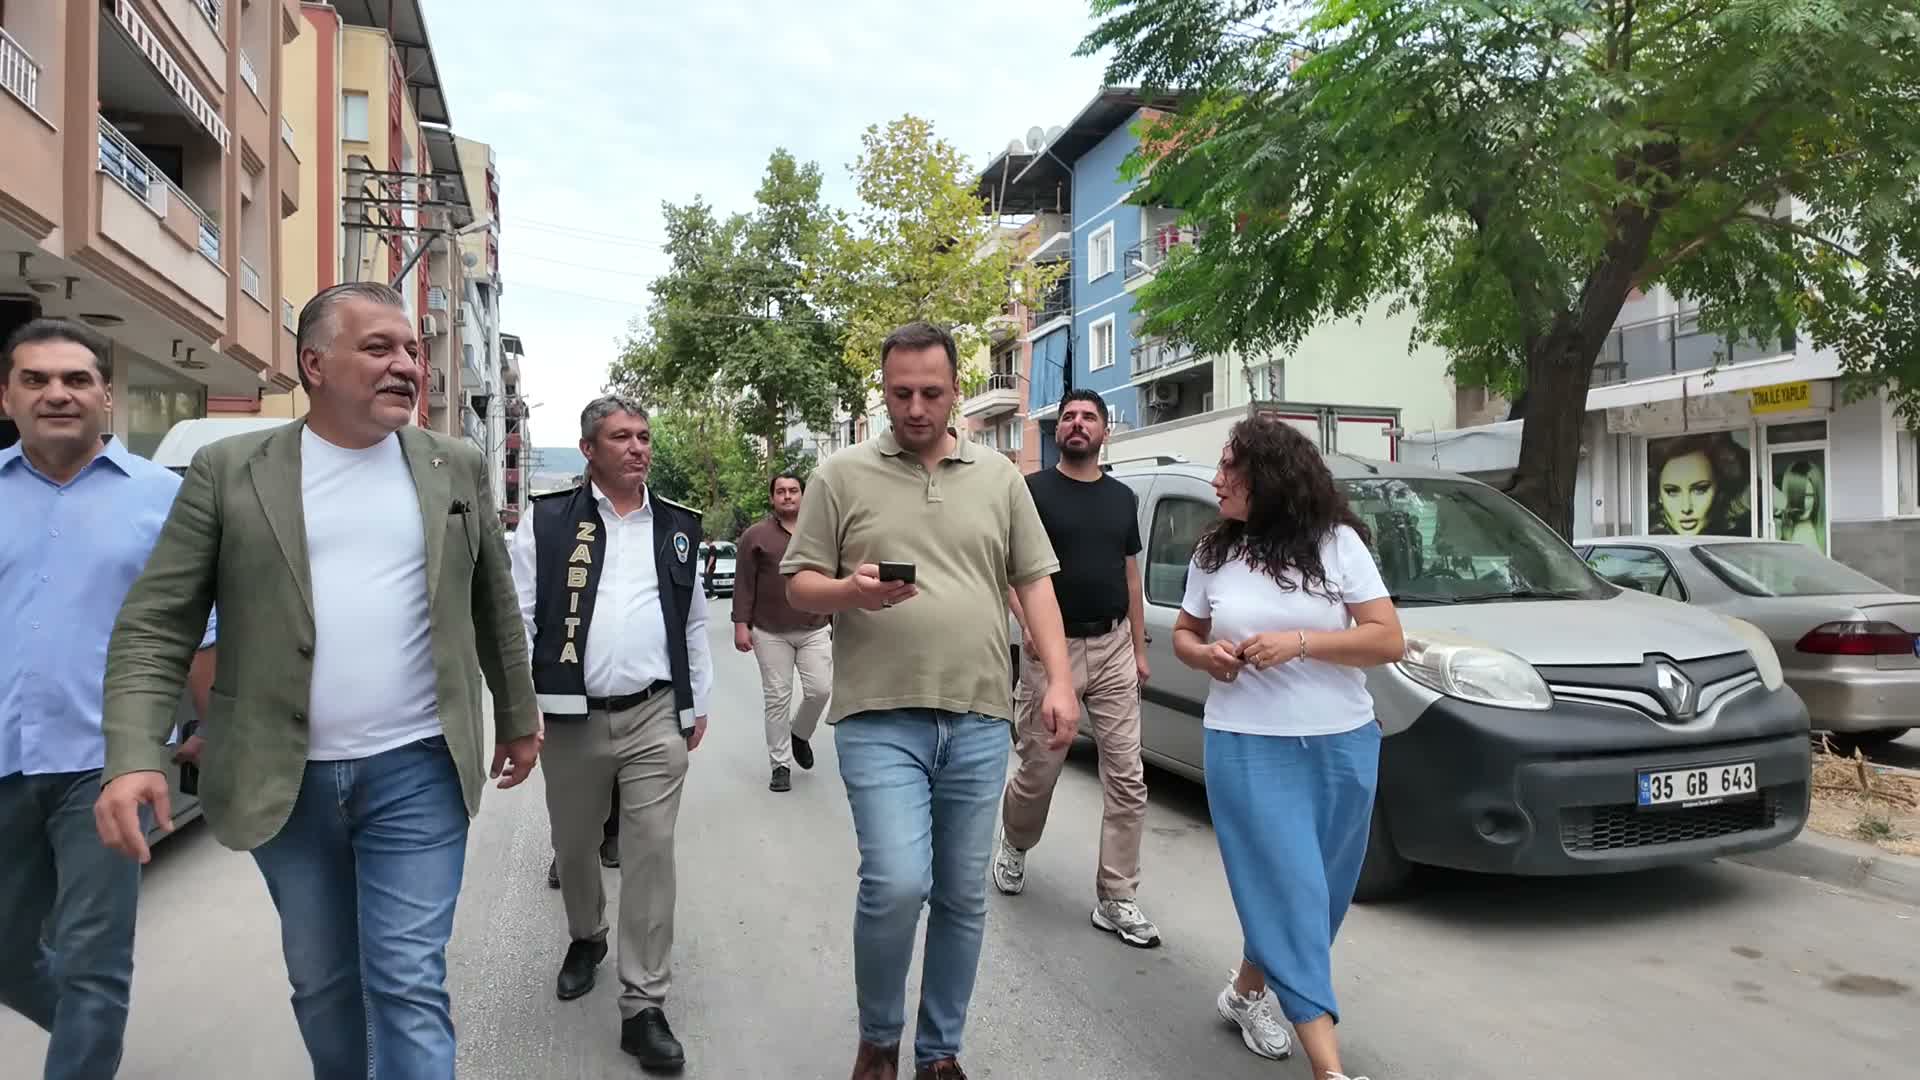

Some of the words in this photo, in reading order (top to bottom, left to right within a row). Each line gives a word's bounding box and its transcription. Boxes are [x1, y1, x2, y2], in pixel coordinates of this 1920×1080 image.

[559, 522, 597, 664] ZABITA
[1652, 775, 1673, 800] 35
[1687, 771, 1708, 796] GB
[1721, 766, 1753, 791] 643
